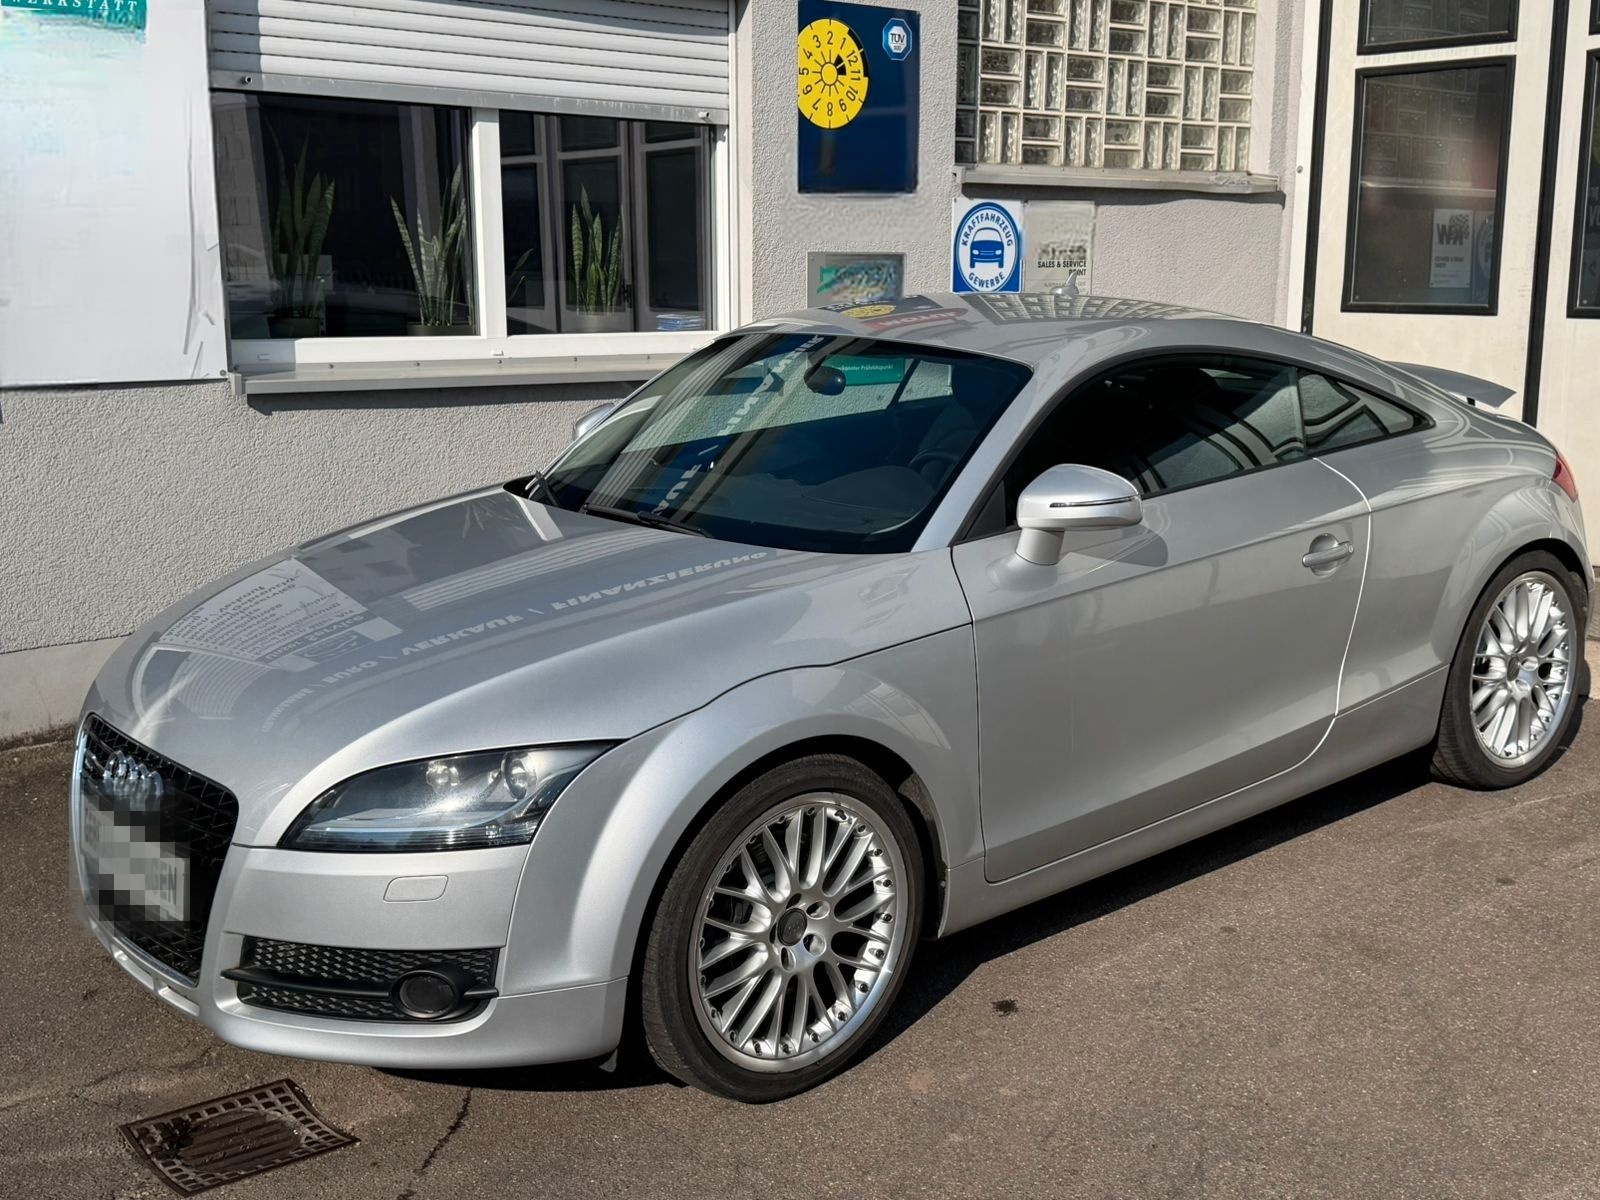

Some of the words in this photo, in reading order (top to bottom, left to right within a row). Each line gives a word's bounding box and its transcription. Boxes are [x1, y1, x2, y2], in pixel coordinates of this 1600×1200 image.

[12, 0, 138, 10] RKSTATT
[812, 34, 822, 48] 3
[827, 30, 833, 45] 2
[840, 37, 846, 50] 1
[803, 48, 813, 60] 4
[846, 49, 858, 67] 12
[798, 67, 809, 76] 5
[850, 69, 860, 81] 11
[802, 84, 813, 95] 6
[845, 86, 858, 102] 10
[812, 98, 821, 111] 7
[827, 101, 833, 117] 8
[838, 98, 847, 112] 9
[961, 212, 1014, 247] KRAFTFAHRZEUG
[1037, 260, 1055, 268] SALES
[1056, 260, 1061, 268] &
[1062, 260, 1087, 268] SERVICE
[968, 272, 1005, 288] GEWERBE
